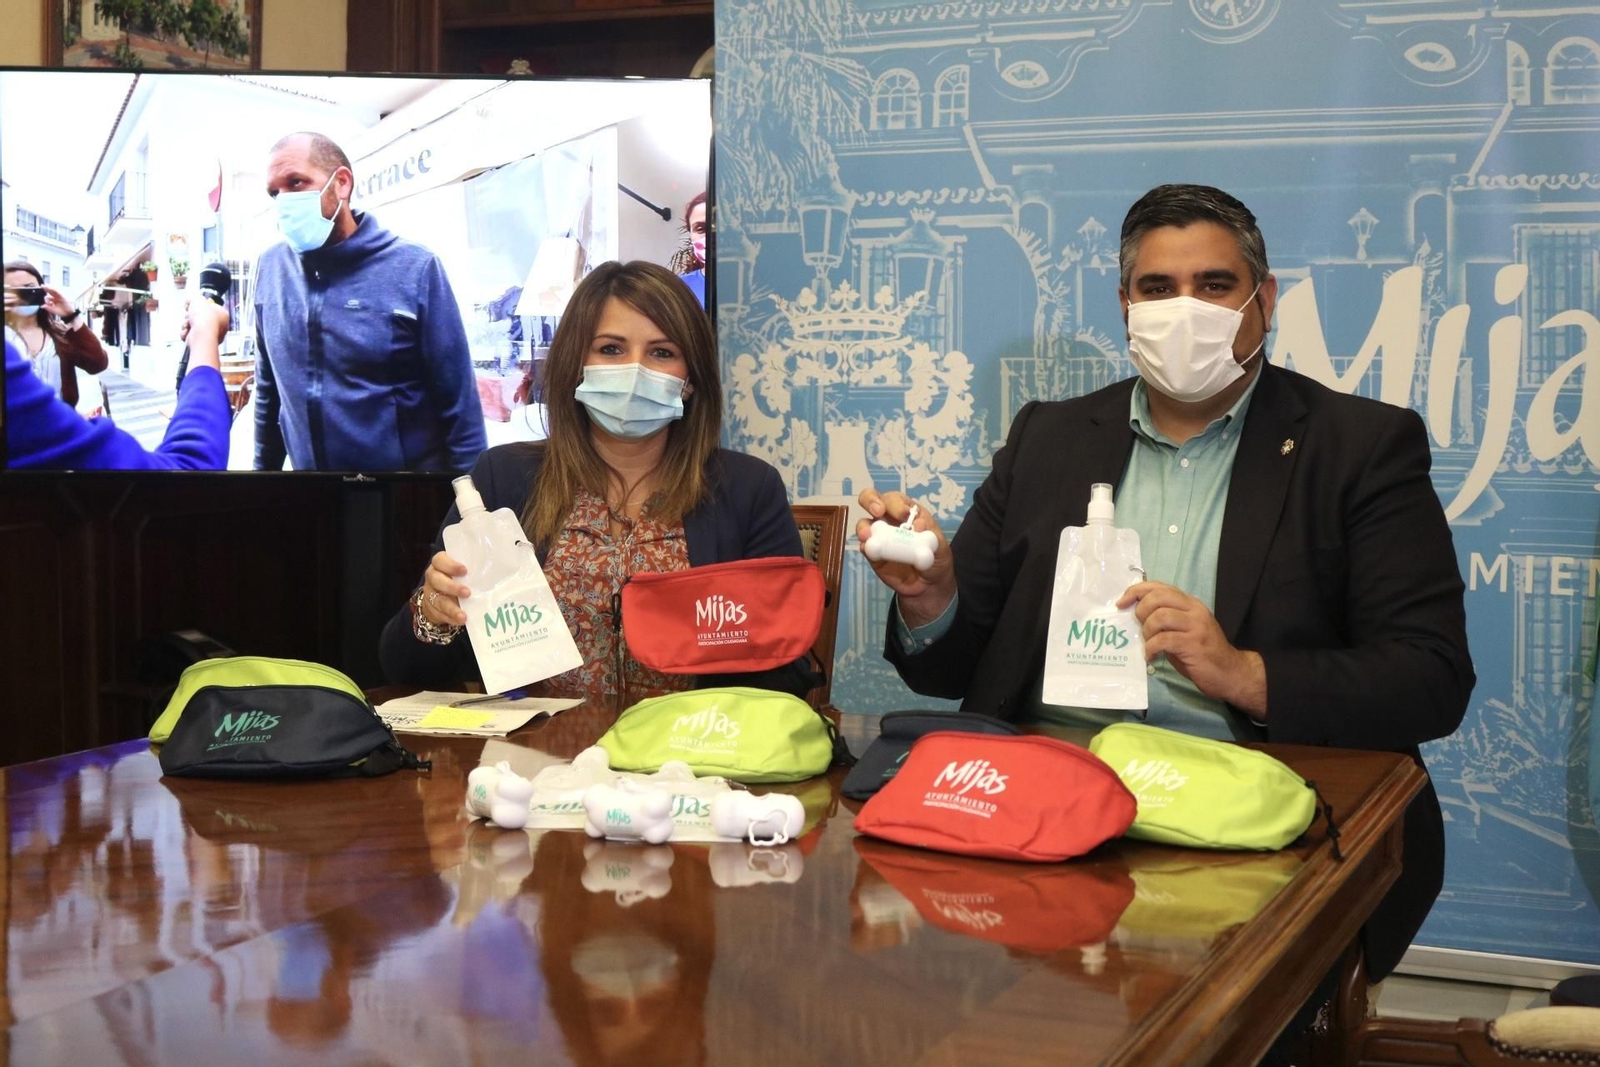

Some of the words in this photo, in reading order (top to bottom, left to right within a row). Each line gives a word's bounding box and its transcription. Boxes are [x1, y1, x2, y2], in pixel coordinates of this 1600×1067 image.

[356, 149, 432, 200] errace
[1271, 264, 1600, 523] Mija
[484, 602, 542, 637] Mijas
[696, 595, 748, 632] Mijas
[491, 627, 548, 649] AYUNTAMIENTO
[1067, 618, 1129, 653] Mijas
[1066, 653, 1129, 662] AYUNTAMIENTO
[214, 710, 282, 738] Mijas
[672, 704, 741, 740] Mijas
[933, 759, 1010, 795] Mijas
[1119, 759, 1190, 792] Mijas
[606, 808, 632, 826] Mijas
[925, 792, 998, 814] AYUNTAMIENTO
